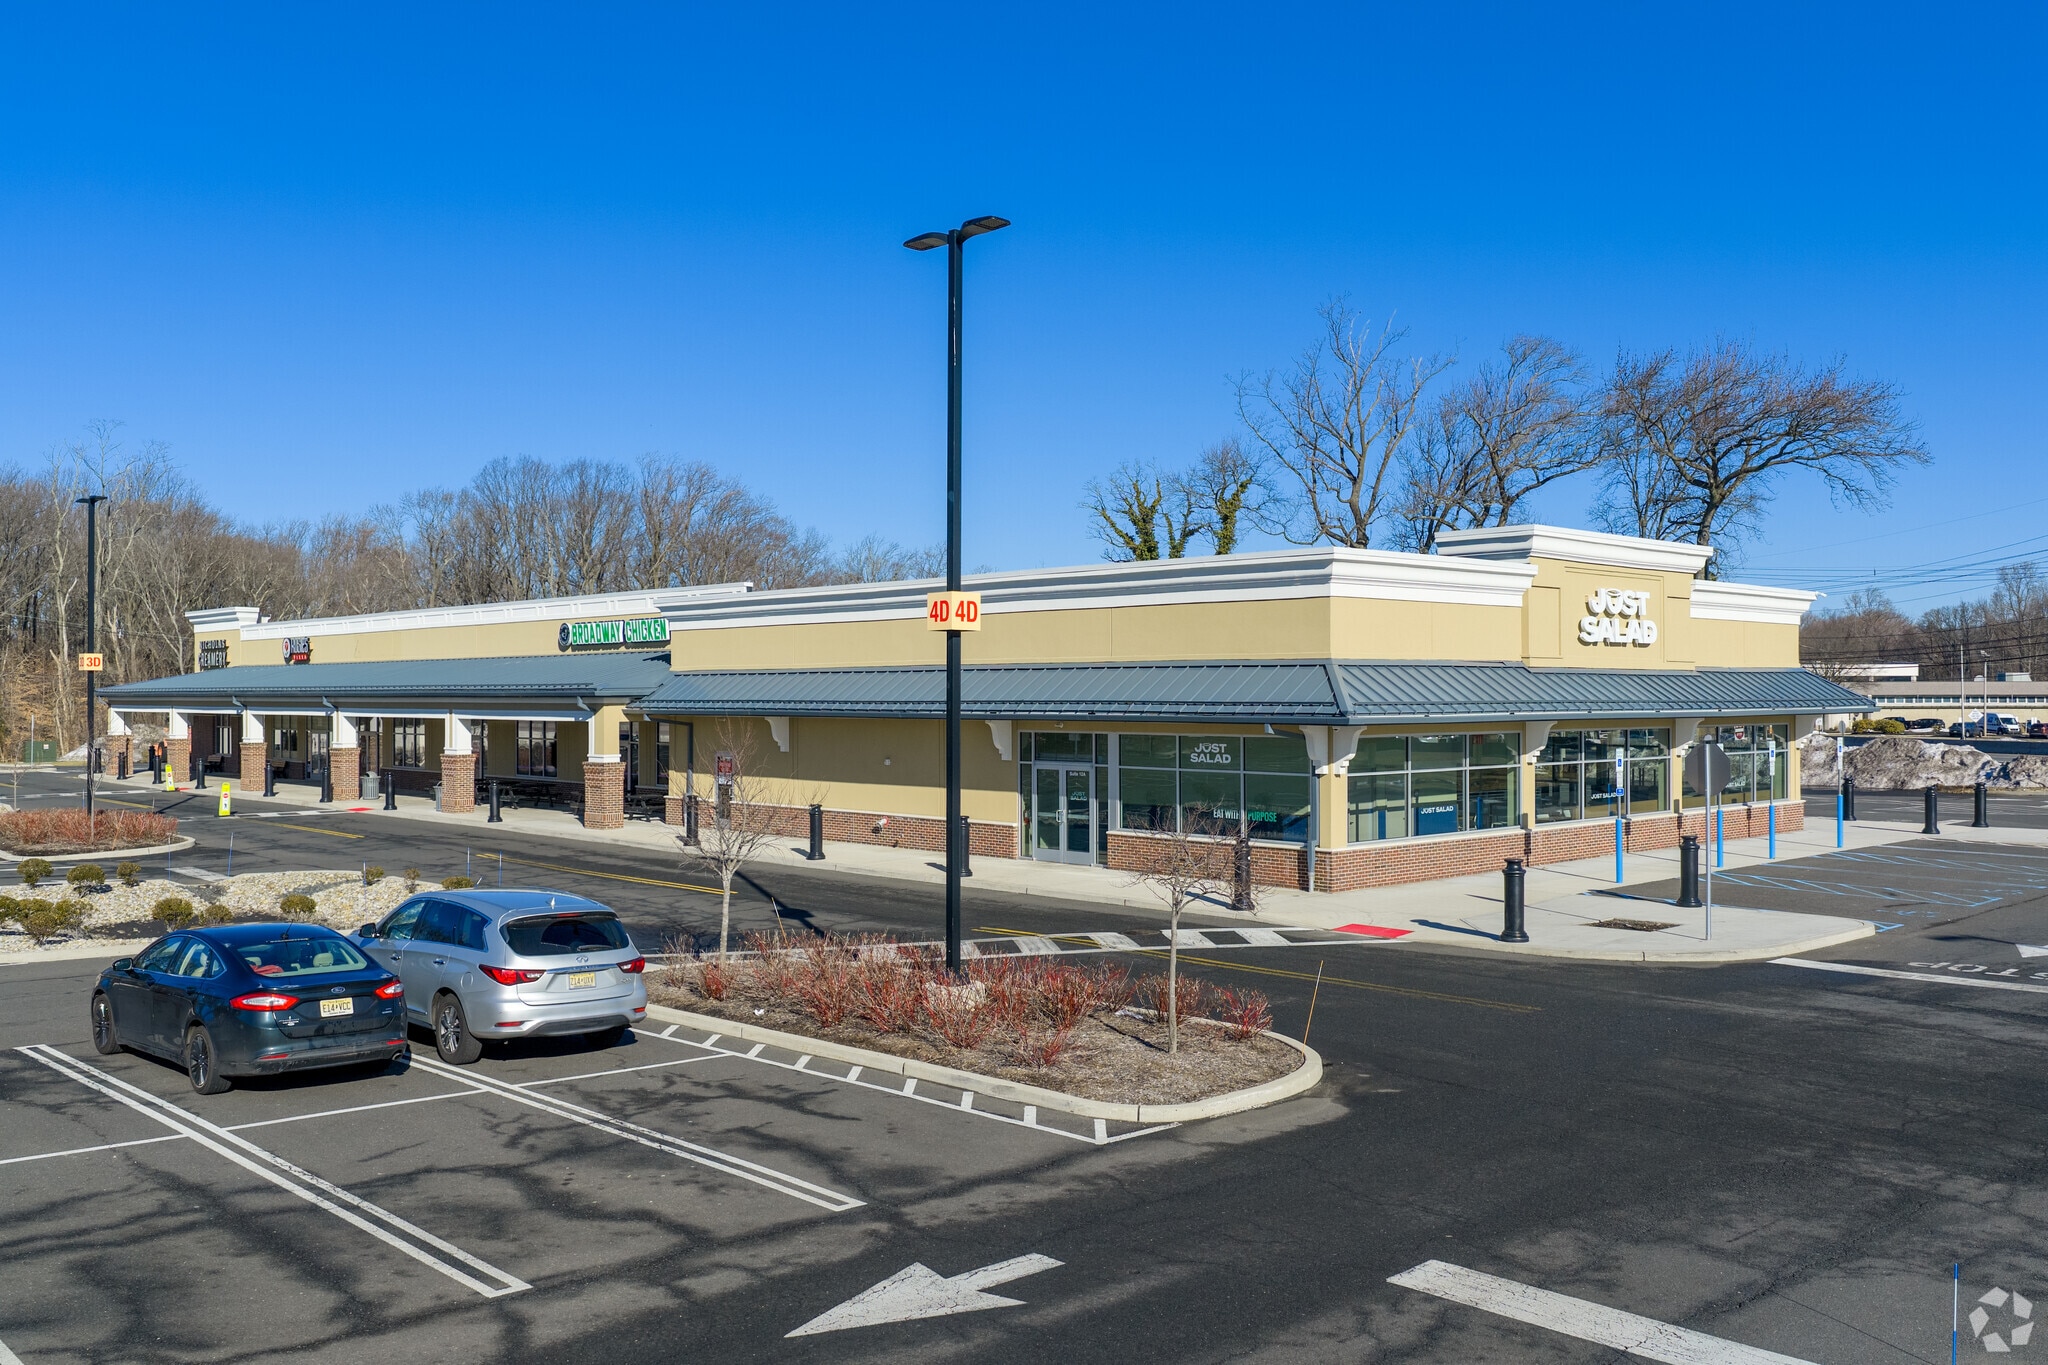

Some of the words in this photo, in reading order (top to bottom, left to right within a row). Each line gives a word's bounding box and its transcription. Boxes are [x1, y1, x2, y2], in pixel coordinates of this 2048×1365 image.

[1587, 588, 1651, 616] JUST
[929, 600, 950, 623] 4D
[955, 600, 978, 623] 4D
[571, 621, 622, 645] BROADWAY
[625, 618, 667, 642] CHICKEN
[1579, 616, 1658, 644] SALAD
[86, 656, 101, 667] 3D
[198, 651, 228, 668] CREAMERY
[1194, 742, 1228, 753] JUST
[1190, 753, 1232, 764] SALAD
[1213, 809, 1224, 818] EAT
[1247, 811, 1277, 823] PURPOSE
[1435, 805, 1454, 813] SALAD
